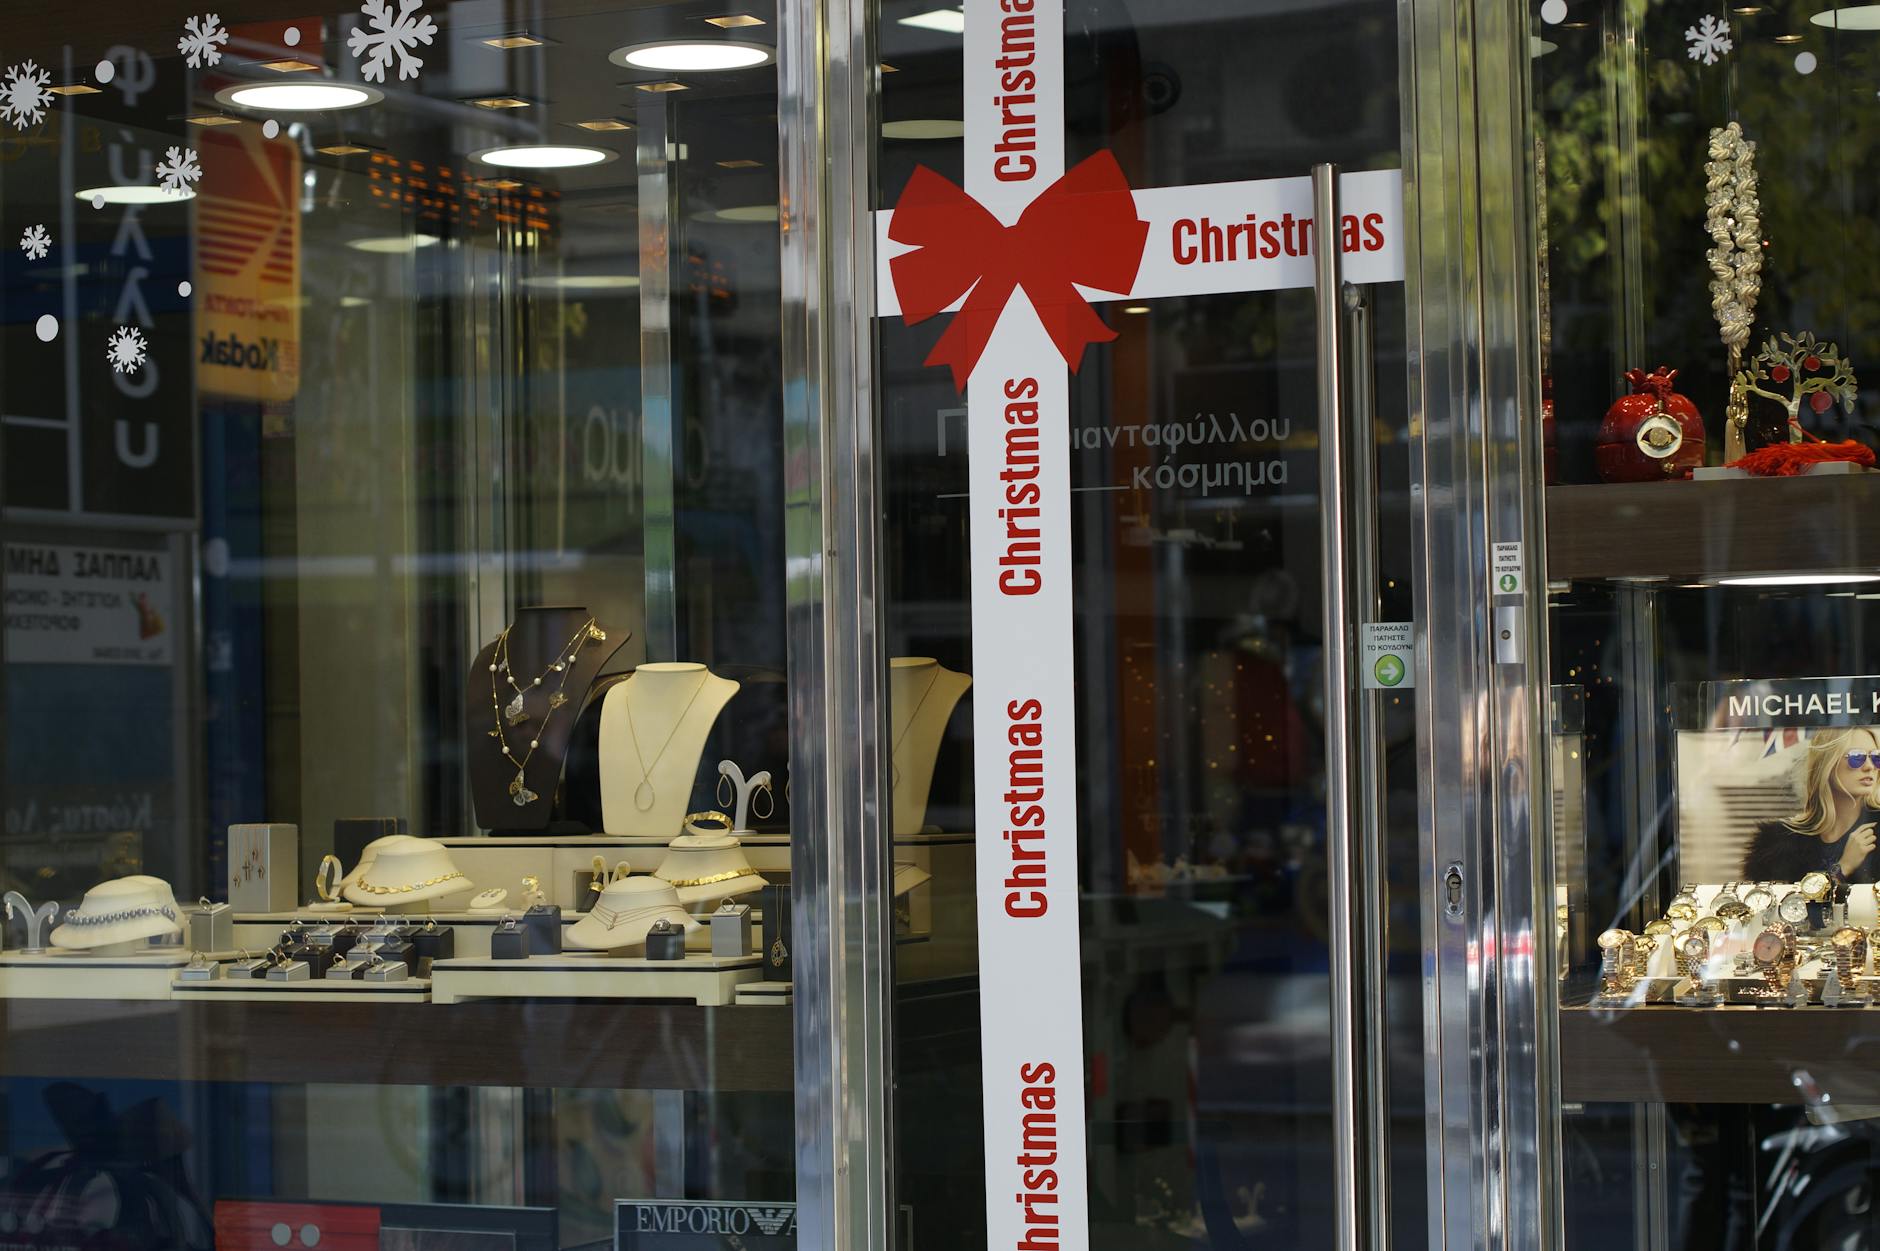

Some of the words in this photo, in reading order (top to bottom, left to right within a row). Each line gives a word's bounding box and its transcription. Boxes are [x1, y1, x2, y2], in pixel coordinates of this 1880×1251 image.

[995, 0, 1037, 182] Christma
[998, 378, 1042, 597] Christmas
[1070, 413, 1291, 454] ιανταφύλλου
[1132, 455, 1288, 497] κόσμημα
[1728, 692, 1860, 718] MICHAEL
[1004, 699, 1047, 918] Christmas
[1016, 1062, 1060, 1251] hristmas
[636, 1205, 750, 1235] EMPORIO
